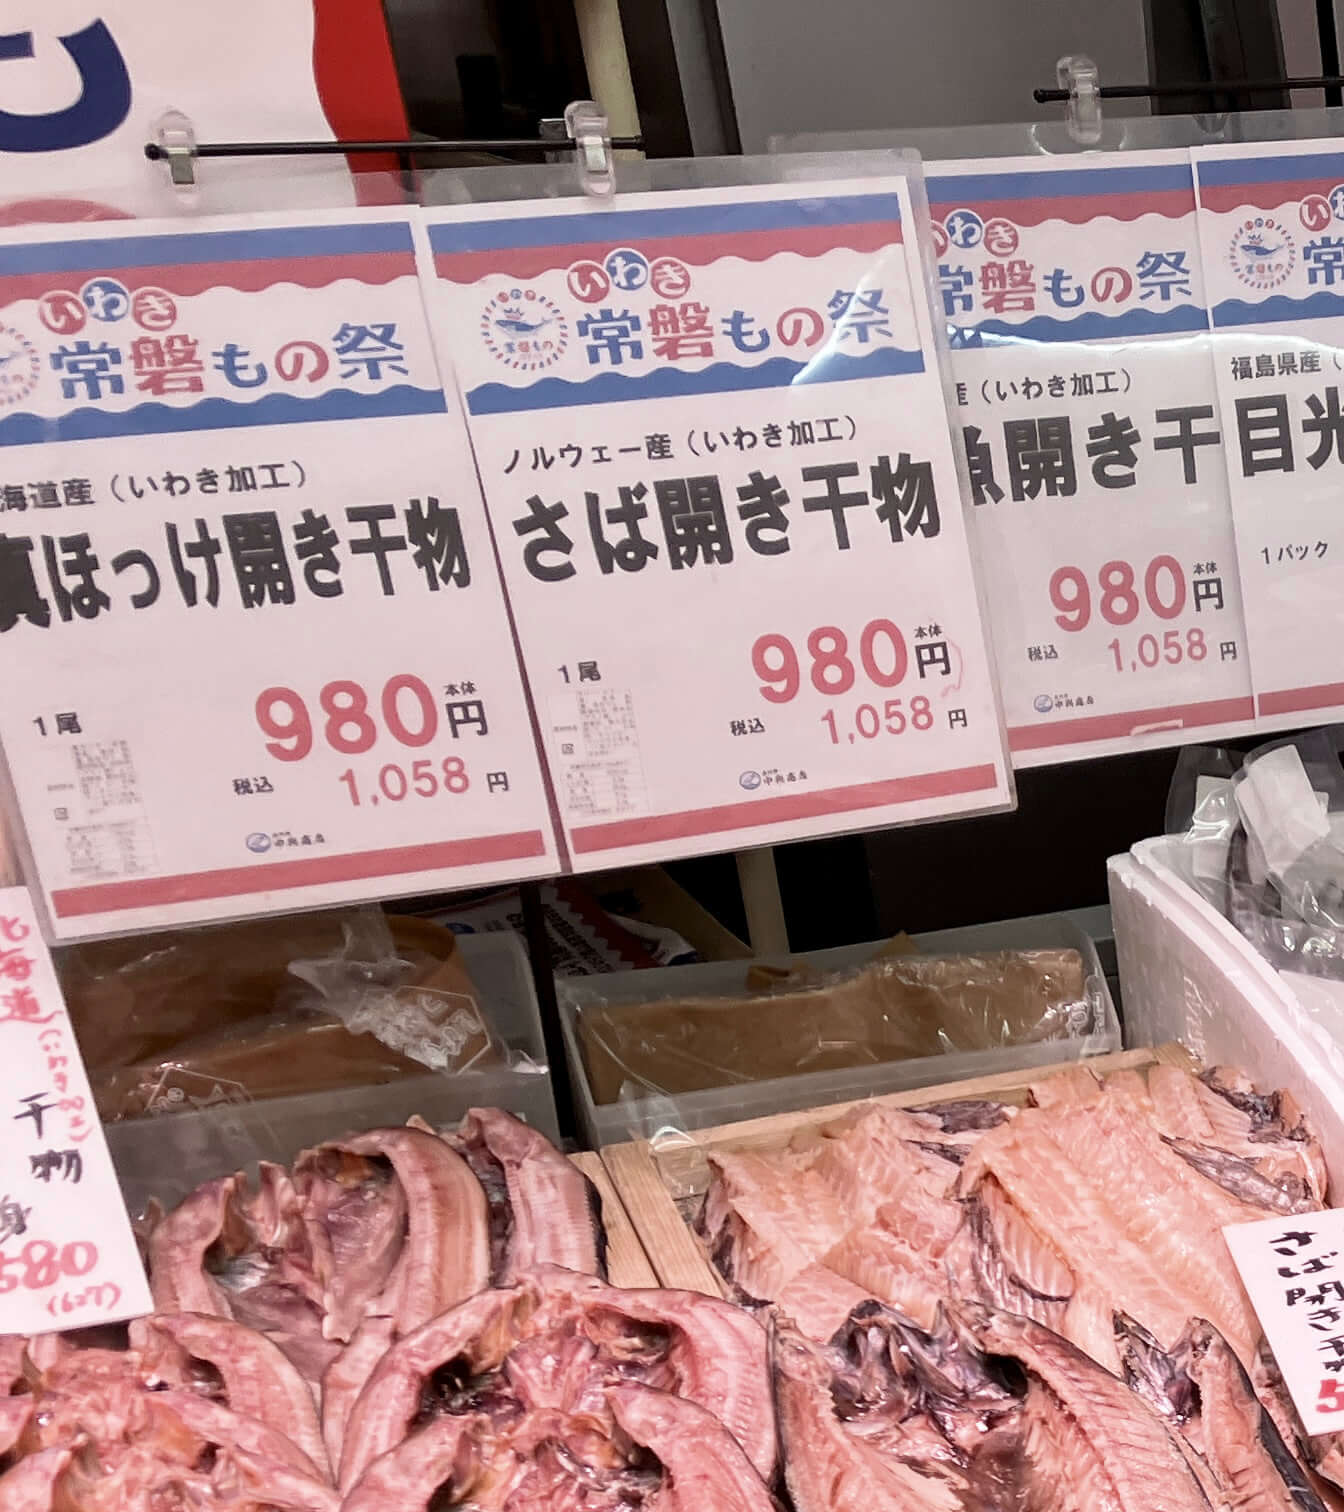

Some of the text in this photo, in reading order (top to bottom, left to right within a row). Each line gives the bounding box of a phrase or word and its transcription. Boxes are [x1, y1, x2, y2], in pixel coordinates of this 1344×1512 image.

[577, 289, 893, 366] 常磐もの祭
[49, 321, 409, 400] 常磐もの祭
[512, 452, 942, 583] さば開き干物
[1106, 628, 1208, 674] 1,058
[821, 695, 935, 745] 1,058
[340, 756, 471, 808] 1,058
